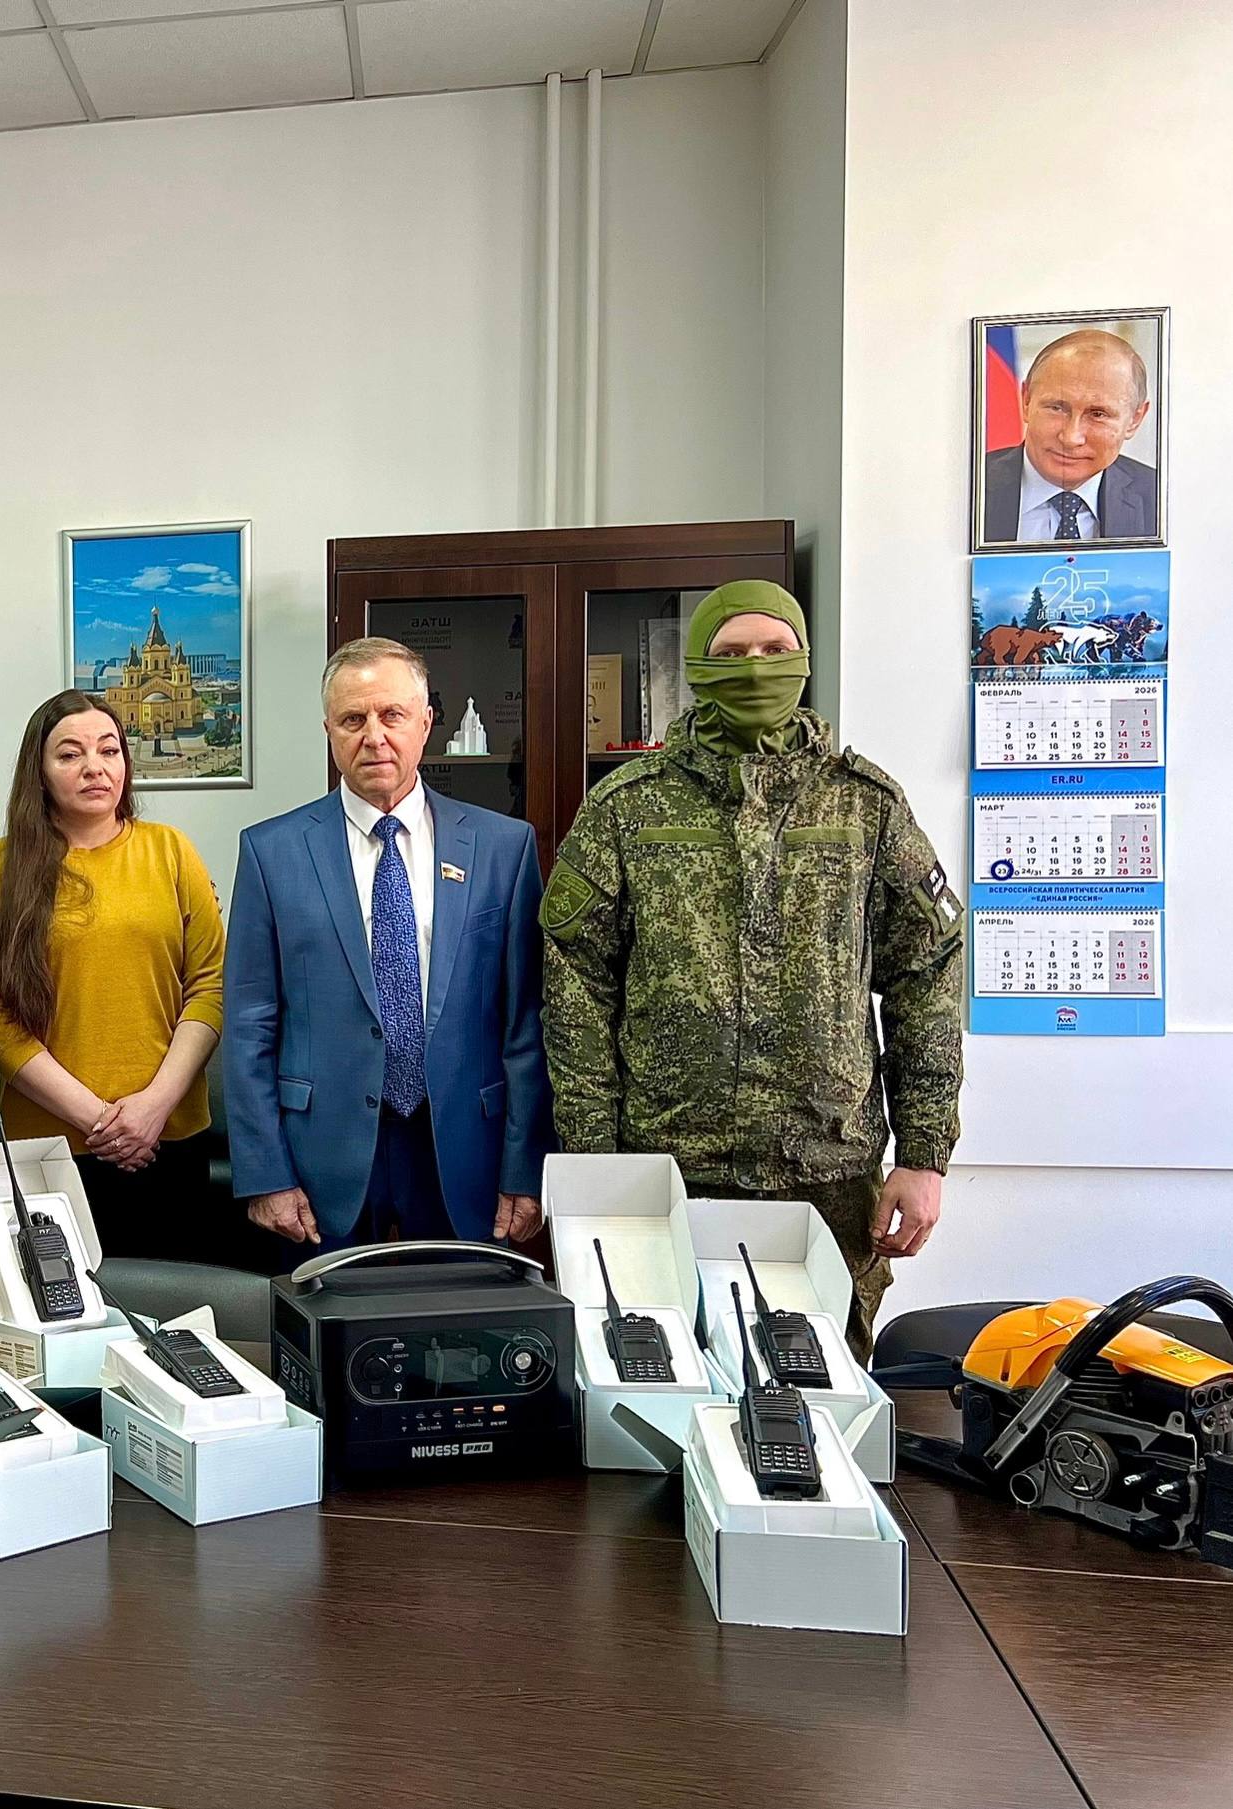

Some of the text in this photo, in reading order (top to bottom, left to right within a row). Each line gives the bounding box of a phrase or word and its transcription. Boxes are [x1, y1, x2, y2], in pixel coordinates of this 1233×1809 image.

[1040, 566, 1109, 620] 25
[1037, 608, 1062, 620] ЛЕТ
[980, 689, 1022, 697] ФЕВРАЛЬ
[1005, 732, 1012, 740] 9
[1093, 741, 1107, 749] 20
[1051, 775, 1084, 784] ER.RU
[980, 802, 1157, 812] МАРТ 2026
[1095, 846, 1105, 854] 13
[1093, 857, 1107, 865] 20
[1021, 867, 1042, 876] 24/31
[1071, 868, 1083, 876] 26
[1094, 868, 1106, 876] 27
[988, 886, 1053, 894] ВСЕРОССИЙСКАЯ
[1054, 886, 1114, 894] ПОЛИТИЧЕСКАЯ
[978, 918, 1014, 926] АПРЕЛЬ
[1049, 950, 1056, 958] 8
[1072, 950, 1079, 958] 9
[1093, 951, 1104, 959] 10
[1069, 972, 1081, 980] 23
[1092, 972, 1104, 980] 24
